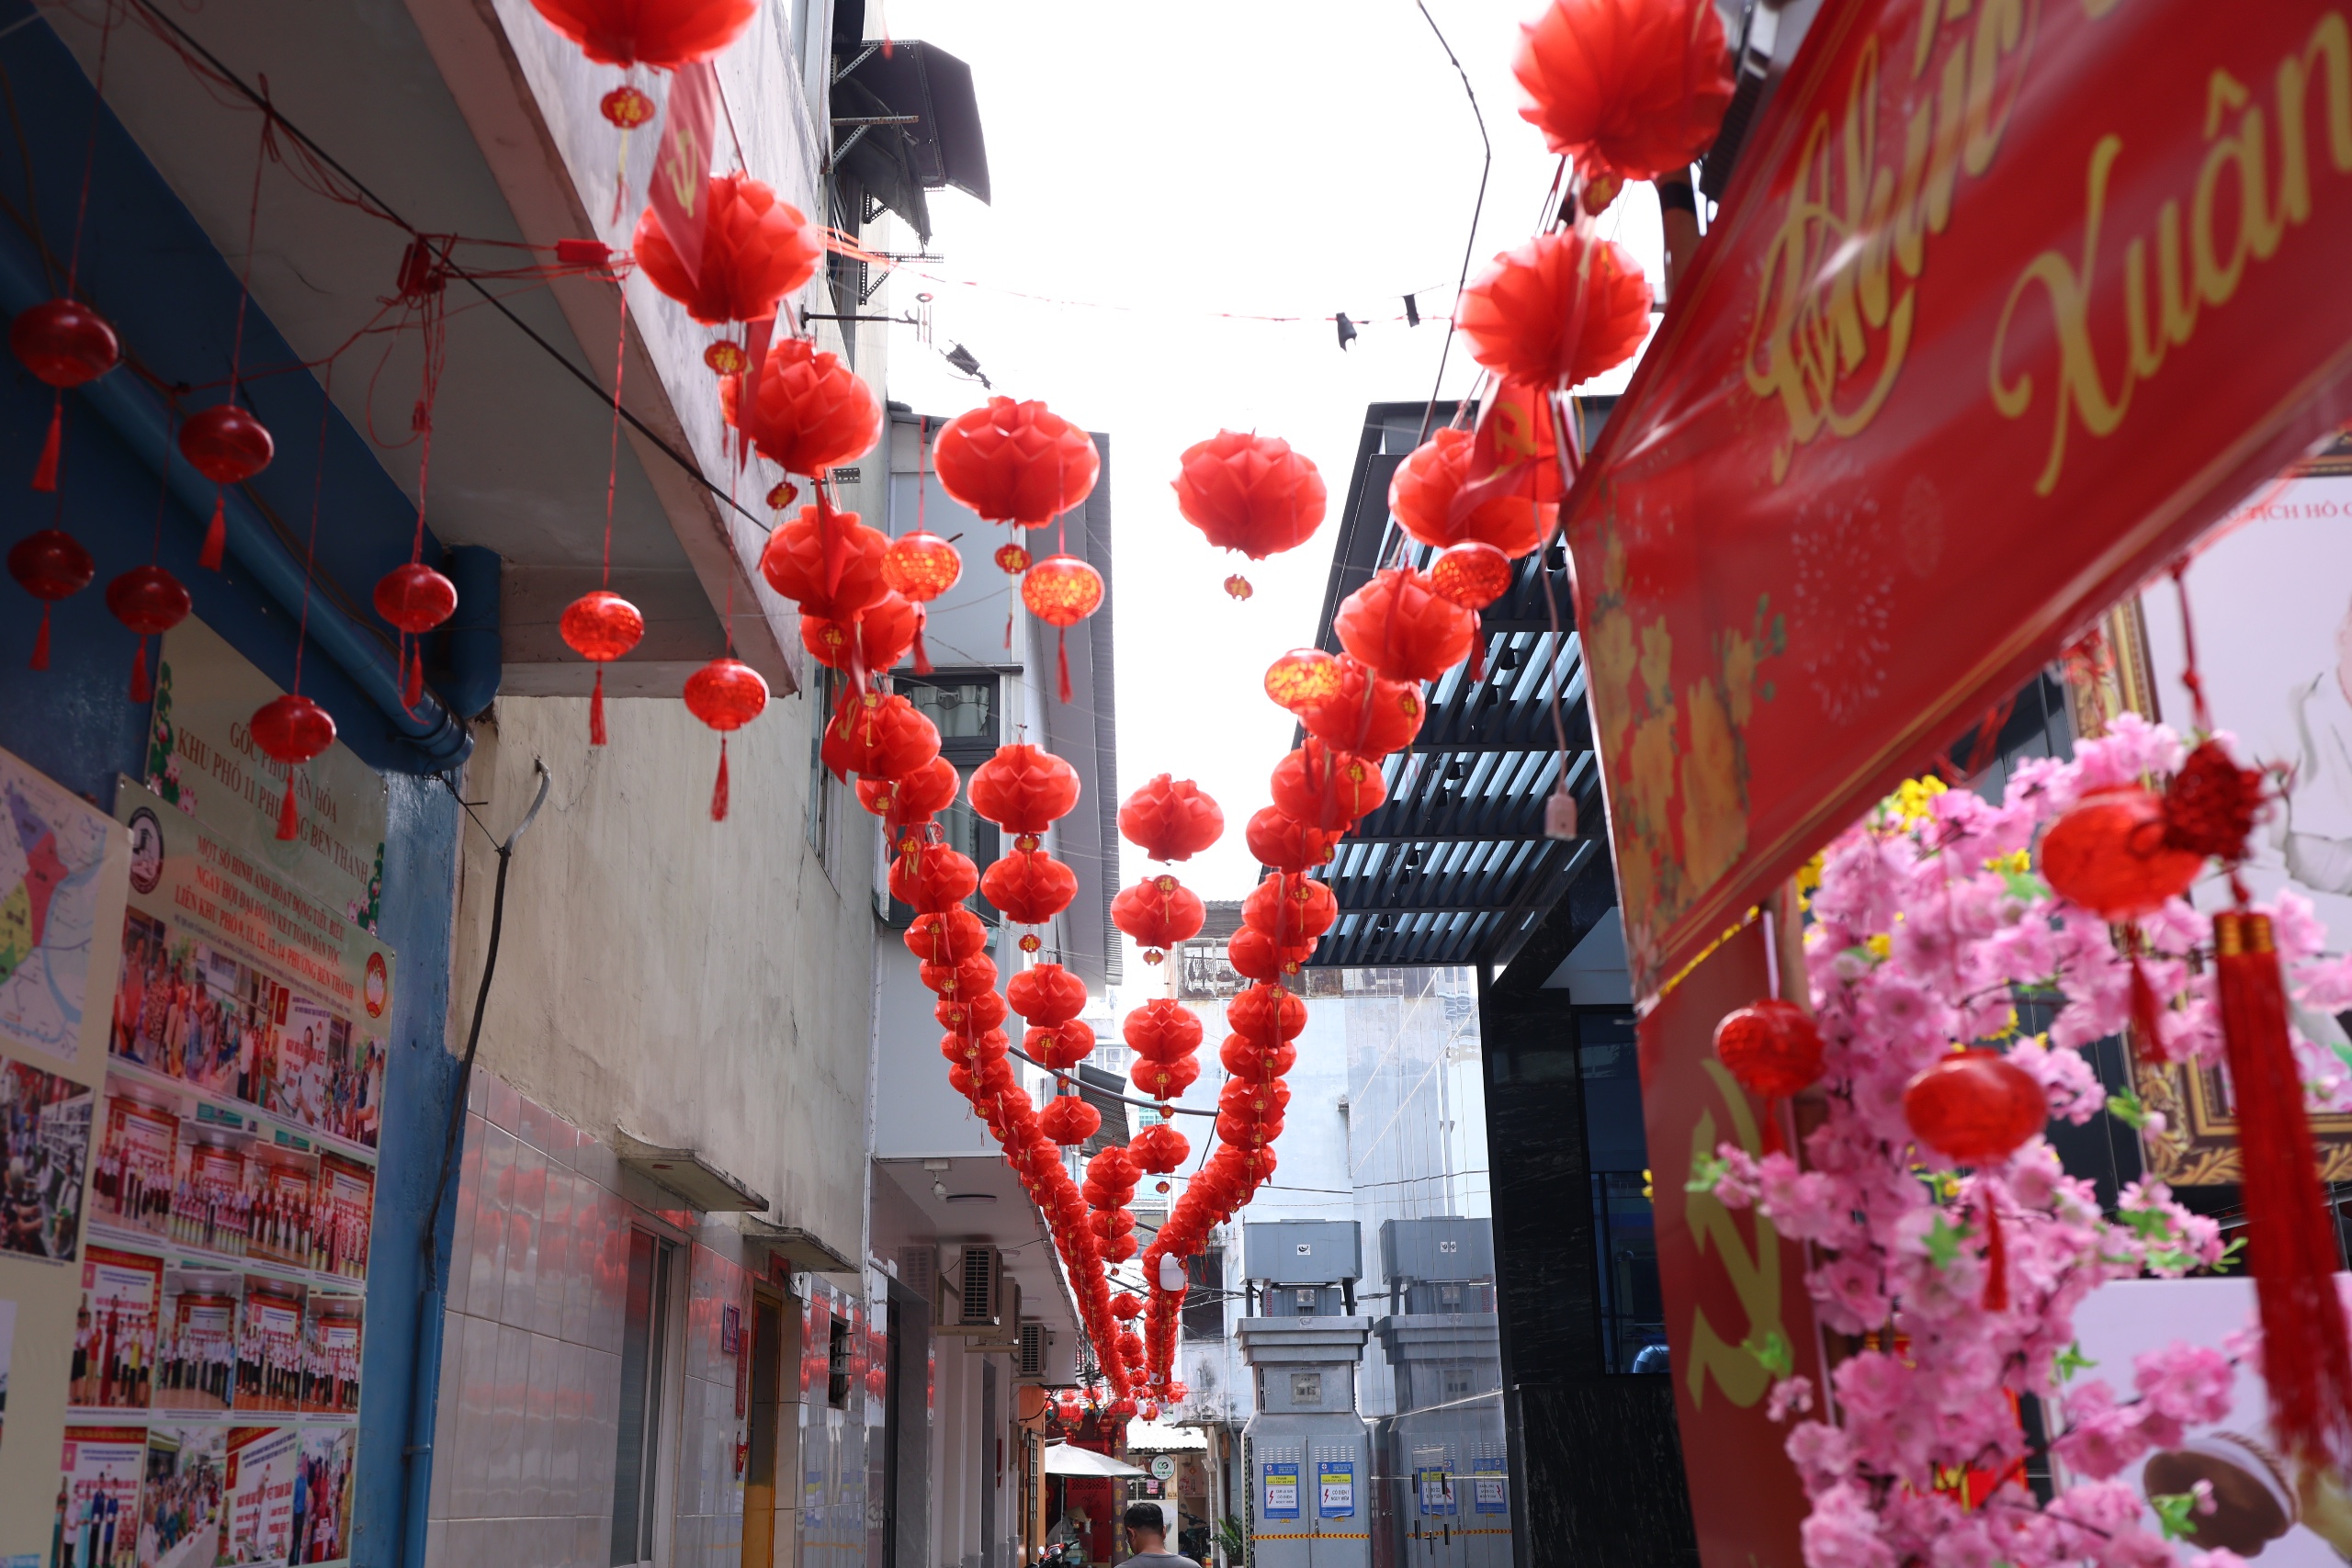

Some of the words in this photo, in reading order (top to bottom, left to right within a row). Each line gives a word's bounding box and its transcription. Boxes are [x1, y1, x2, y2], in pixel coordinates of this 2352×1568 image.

[1989, 11, 2352, 496] Xuân
[1004, 549, 1023, 570] 福
[827, 629, 842, 646] 福
[231, 721, 257, 762] GÓC
[177, 727, 210, 772] KHU
[212, 751, 242, 793] PHỐ
[243, 776, 254, 805] 11
[311, 819, 332, 862] BẾN
[334, 840, 368, 886] THÀNH
[198, 834, 218, 863] MỘT
[220, 845, 231, 870] SỐ
[232, 854, 253, 885] HÌNH
[271, 883, 292, 909] HOẠT
[293, 893, 314, 922] ĐỘNG
[1160, 878, 1173, 892] 福
[196, 864, 221, 895] NGÀY
[222, 877, 239, 907] HỘI
[240, 890, 254, 917] ĐẠI
[254, 899, 276, 927] ĐOÀN
[277, 911, 293, 941] KẾT
[293, 923, 311, 949] TOÀN
[312, 932, 327, 957] DÂN
[327, 943, 341, 967] TỘC
[198, 897, 217, 923] KHU
[219, 908, 238, 934] PHỐ
[287, 948, 316, 980] PHƯỜNG
[317, 964, 331, 986] BẾN
[332, 972, 355, 1000] THÀNH
[1041, 1037, 1052, 1048] 福
[1157, 1074, 1168, 1084] 福
